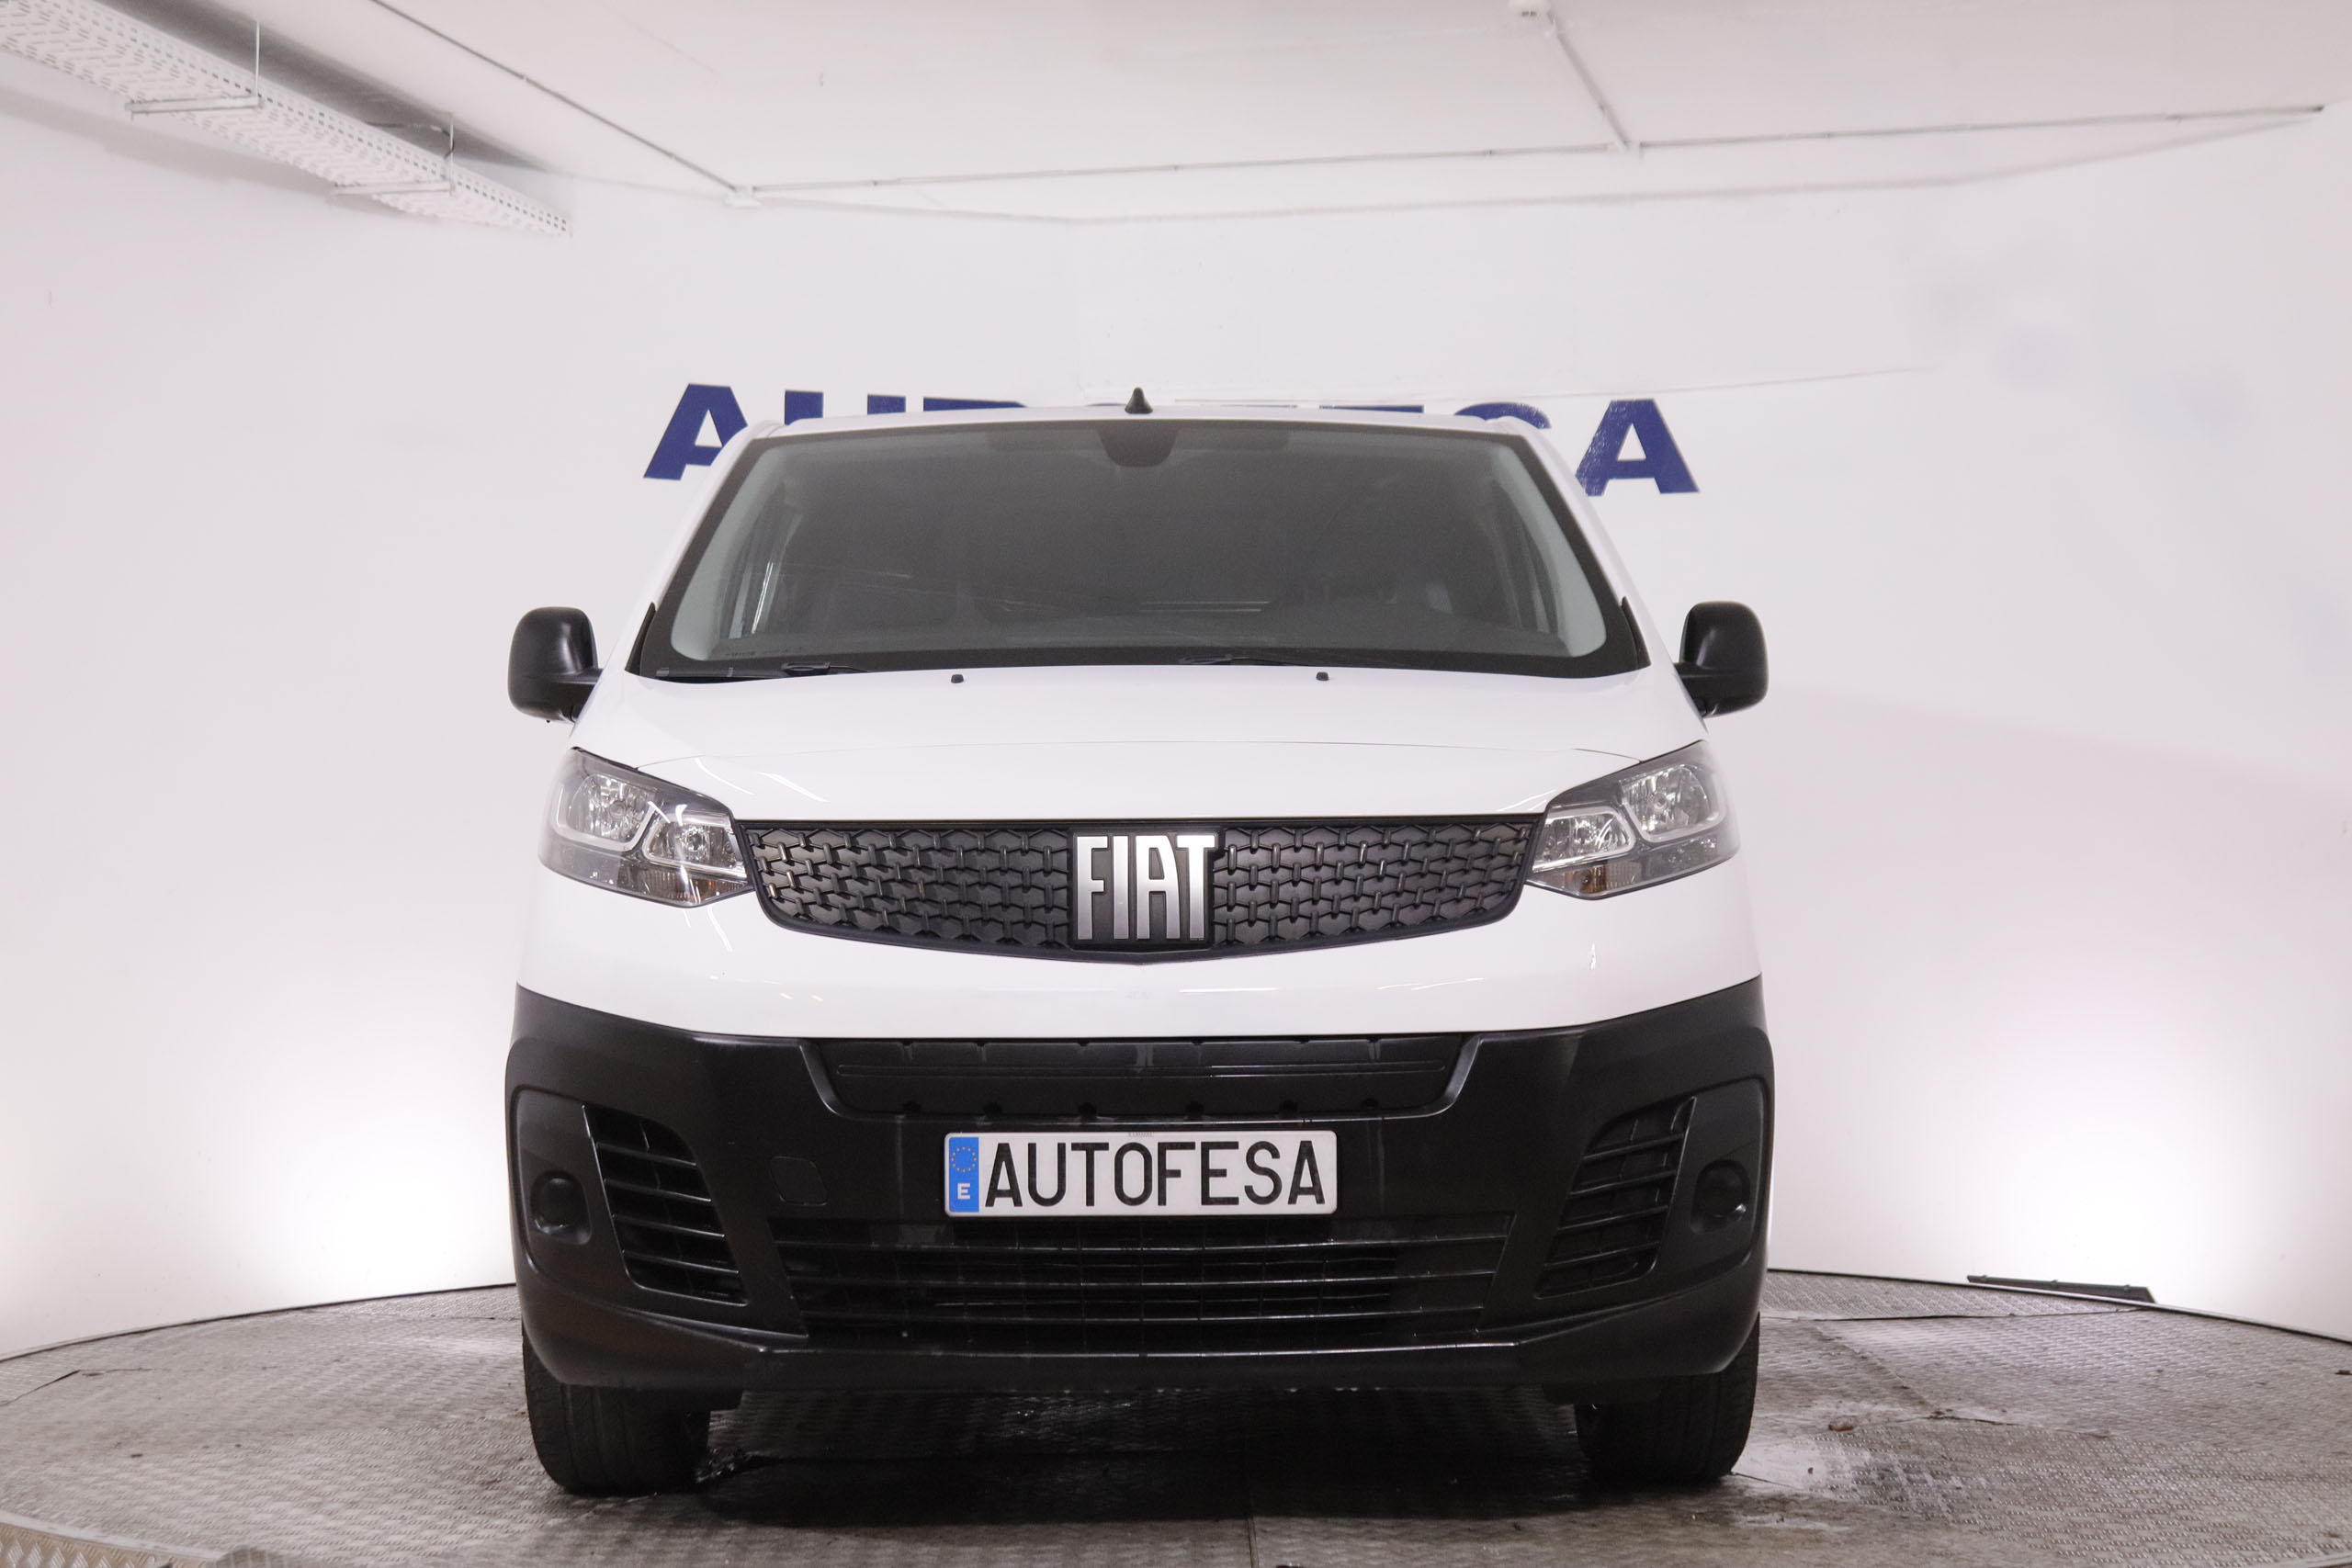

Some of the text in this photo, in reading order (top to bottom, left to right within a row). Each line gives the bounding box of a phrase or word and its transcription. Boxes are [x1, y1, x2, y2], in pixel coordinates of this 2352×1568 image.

[1077, 835, 1216, 940] FIAT
[957, 1182, 971, 1200] E
[985, 1140, 1326, 1207] AUTOFESA
